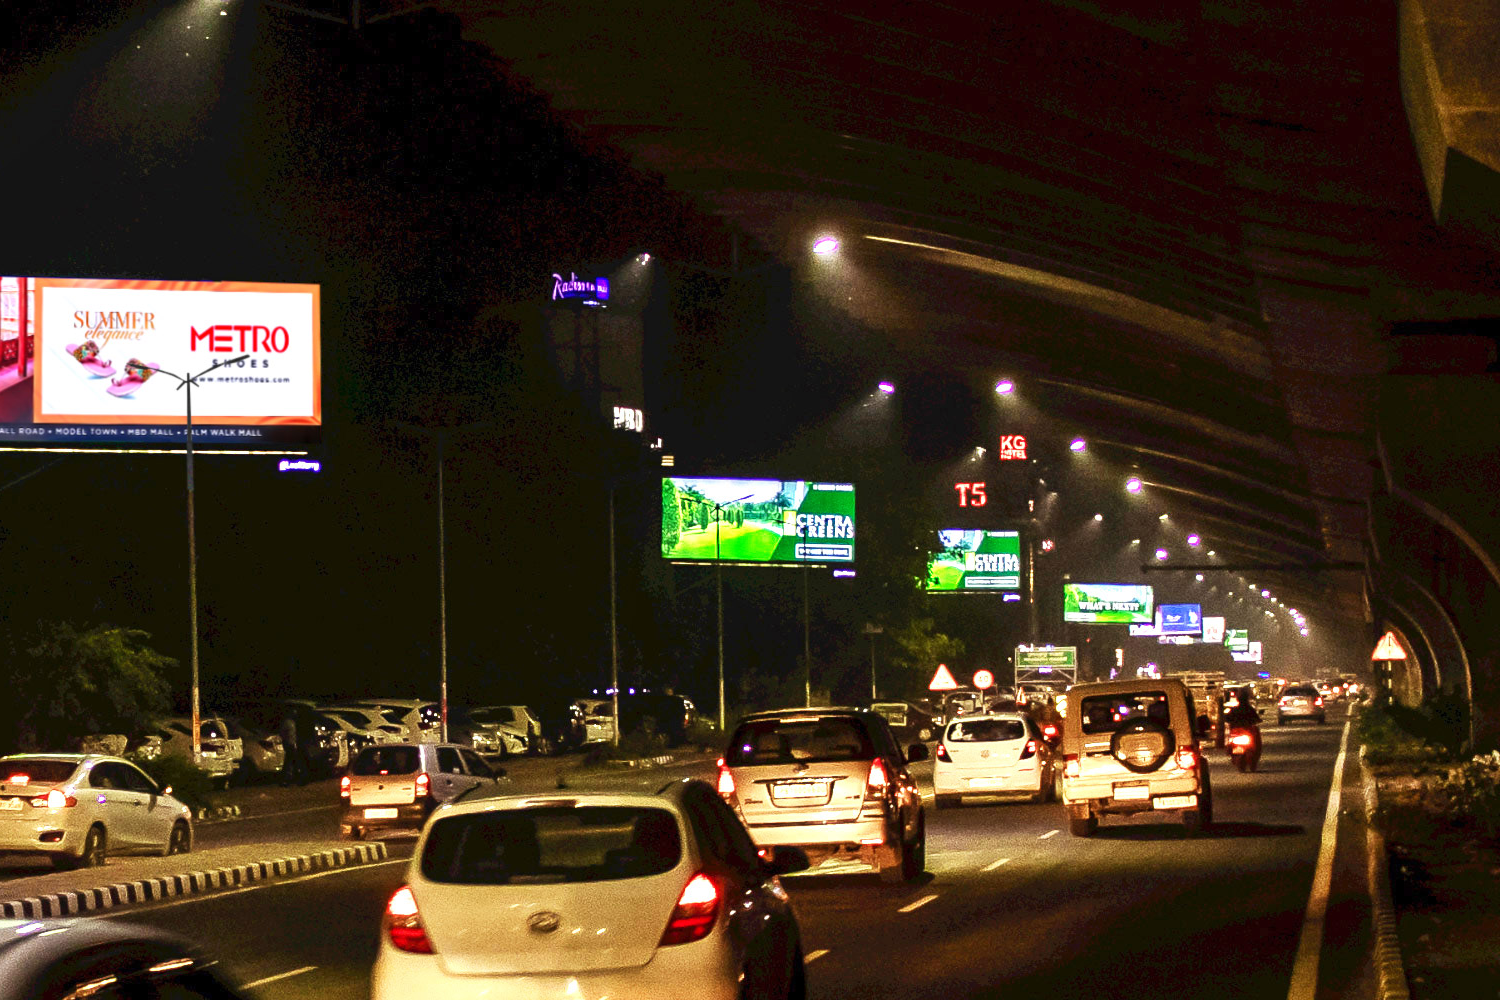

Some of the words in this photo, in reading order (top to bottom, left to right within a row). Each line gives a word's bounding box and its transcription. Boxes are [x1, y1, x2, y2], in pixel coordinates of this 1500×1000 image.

[73, 310, 156, 330] SUMMER
[84, 320, 144, 350] elegance
[190, 325, 290, 353] METRO
[212, 359, 269, 368] SHOES
[19, 428, 45, 436] ROAD
[55, 428, 87, 436] MODEL
[90, 428, 118, 436] TOWN
[127, 428, 146, 436] MBD
[239, 430, 262, 438] MALL
[1000, 435, 1027, 450] KG
[955, 482, 987, 507] T5
[796, 513, 853, 527] CENTRA
[797, 525, 854, 539] GREENS
